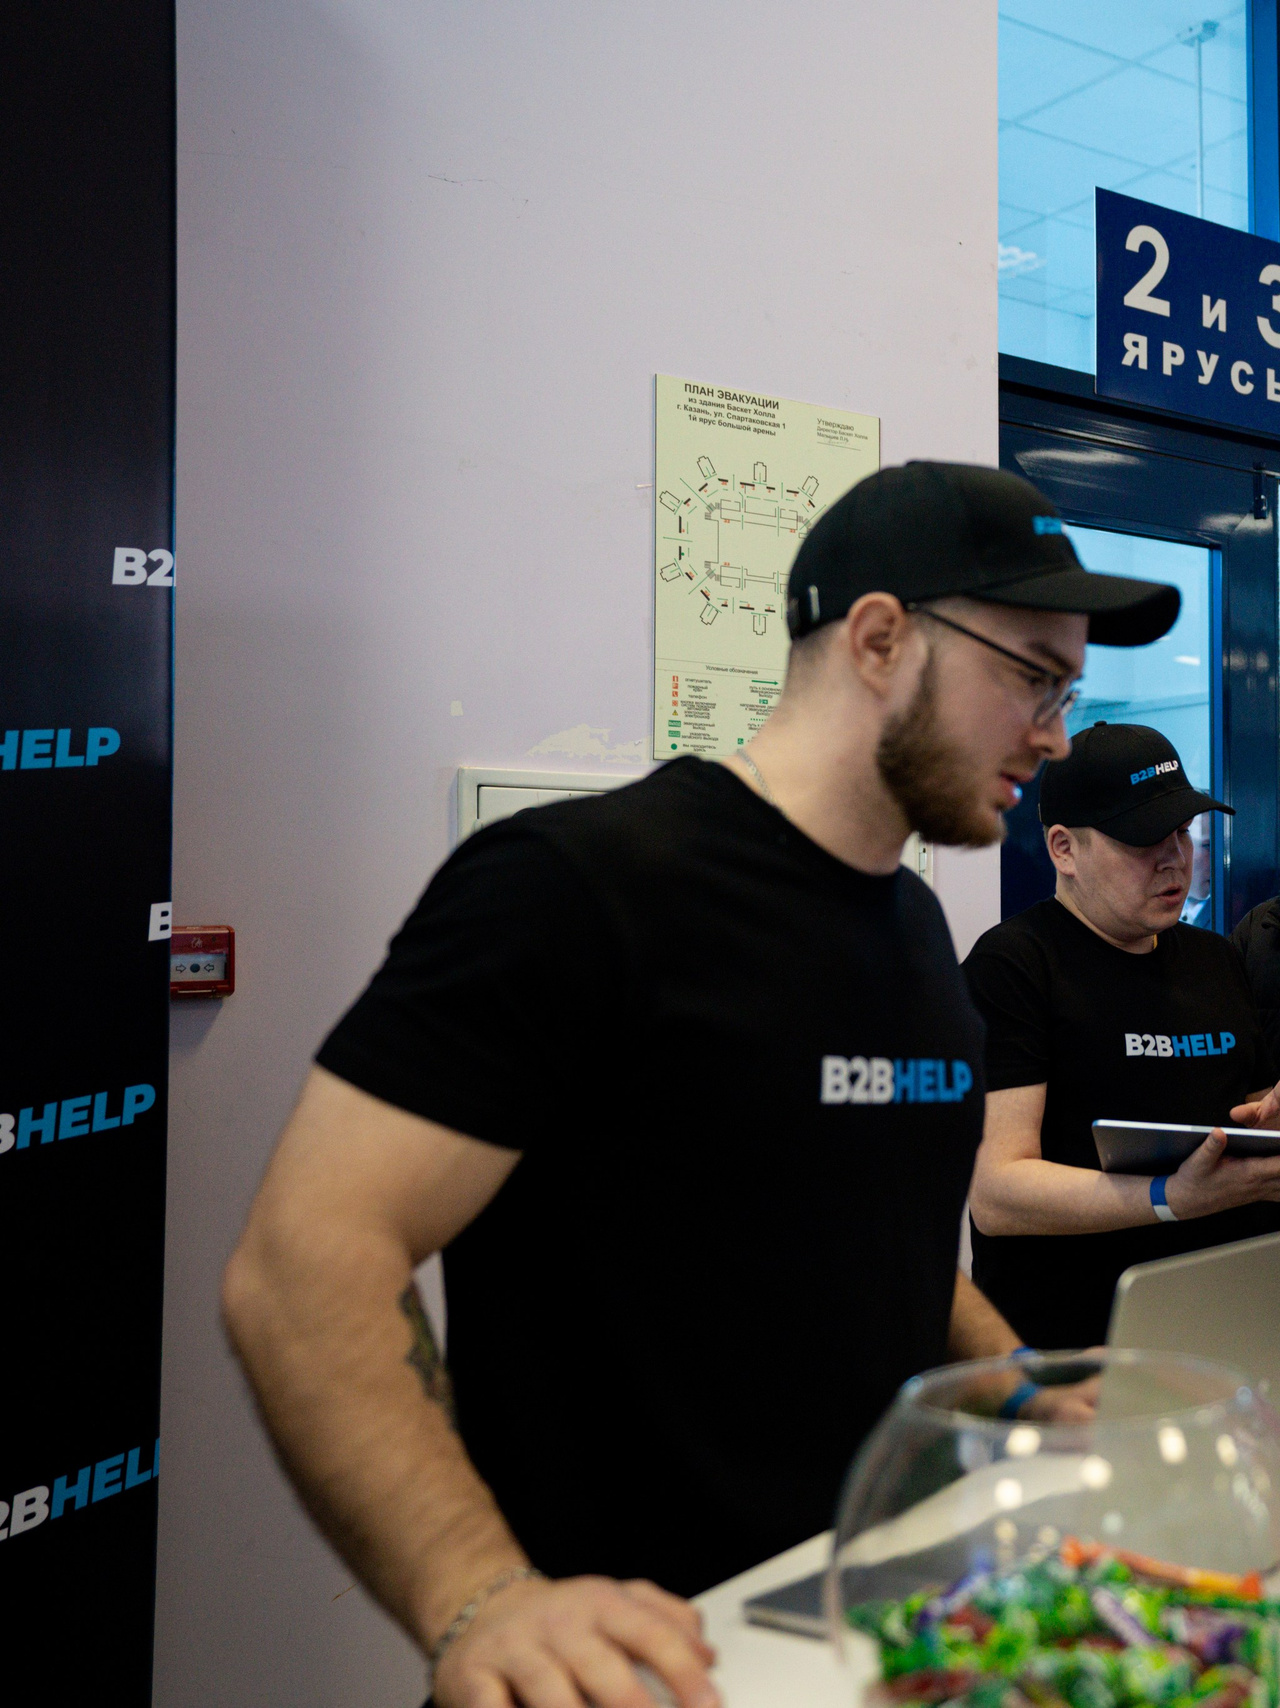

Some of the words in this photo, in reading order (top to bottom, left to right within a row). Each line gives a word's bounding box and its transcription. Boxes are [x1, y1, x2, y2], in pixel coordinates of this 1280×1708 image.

[1124, 225, 1170, 317] 2
[684, 383, 714, 397] ПЛАН
[717, 389, 780, 410] ЭВАКУАЦИИ
[698, 399, 725, 409] здания
[727, 403, 751, 414] Баскет
[753, 409, 776, 419] Холла
[698, 417, 716, 426] ярус
[718, 420, 751, 432] большой
[753, 427, 776, 436] арены
[726, 412, 780, 428] Спартаковская
[817, 418, 854, 431] Утверждаю
[112, 547, 176, 586] B2
[1130, 760, 1179, 785] B2BHELP
[1124, 1031, 1236, 1058] B2BHELP
[820, 1055, 974, 1105] B2BHELP
[0, 1437, 160, 1542] BHEL
